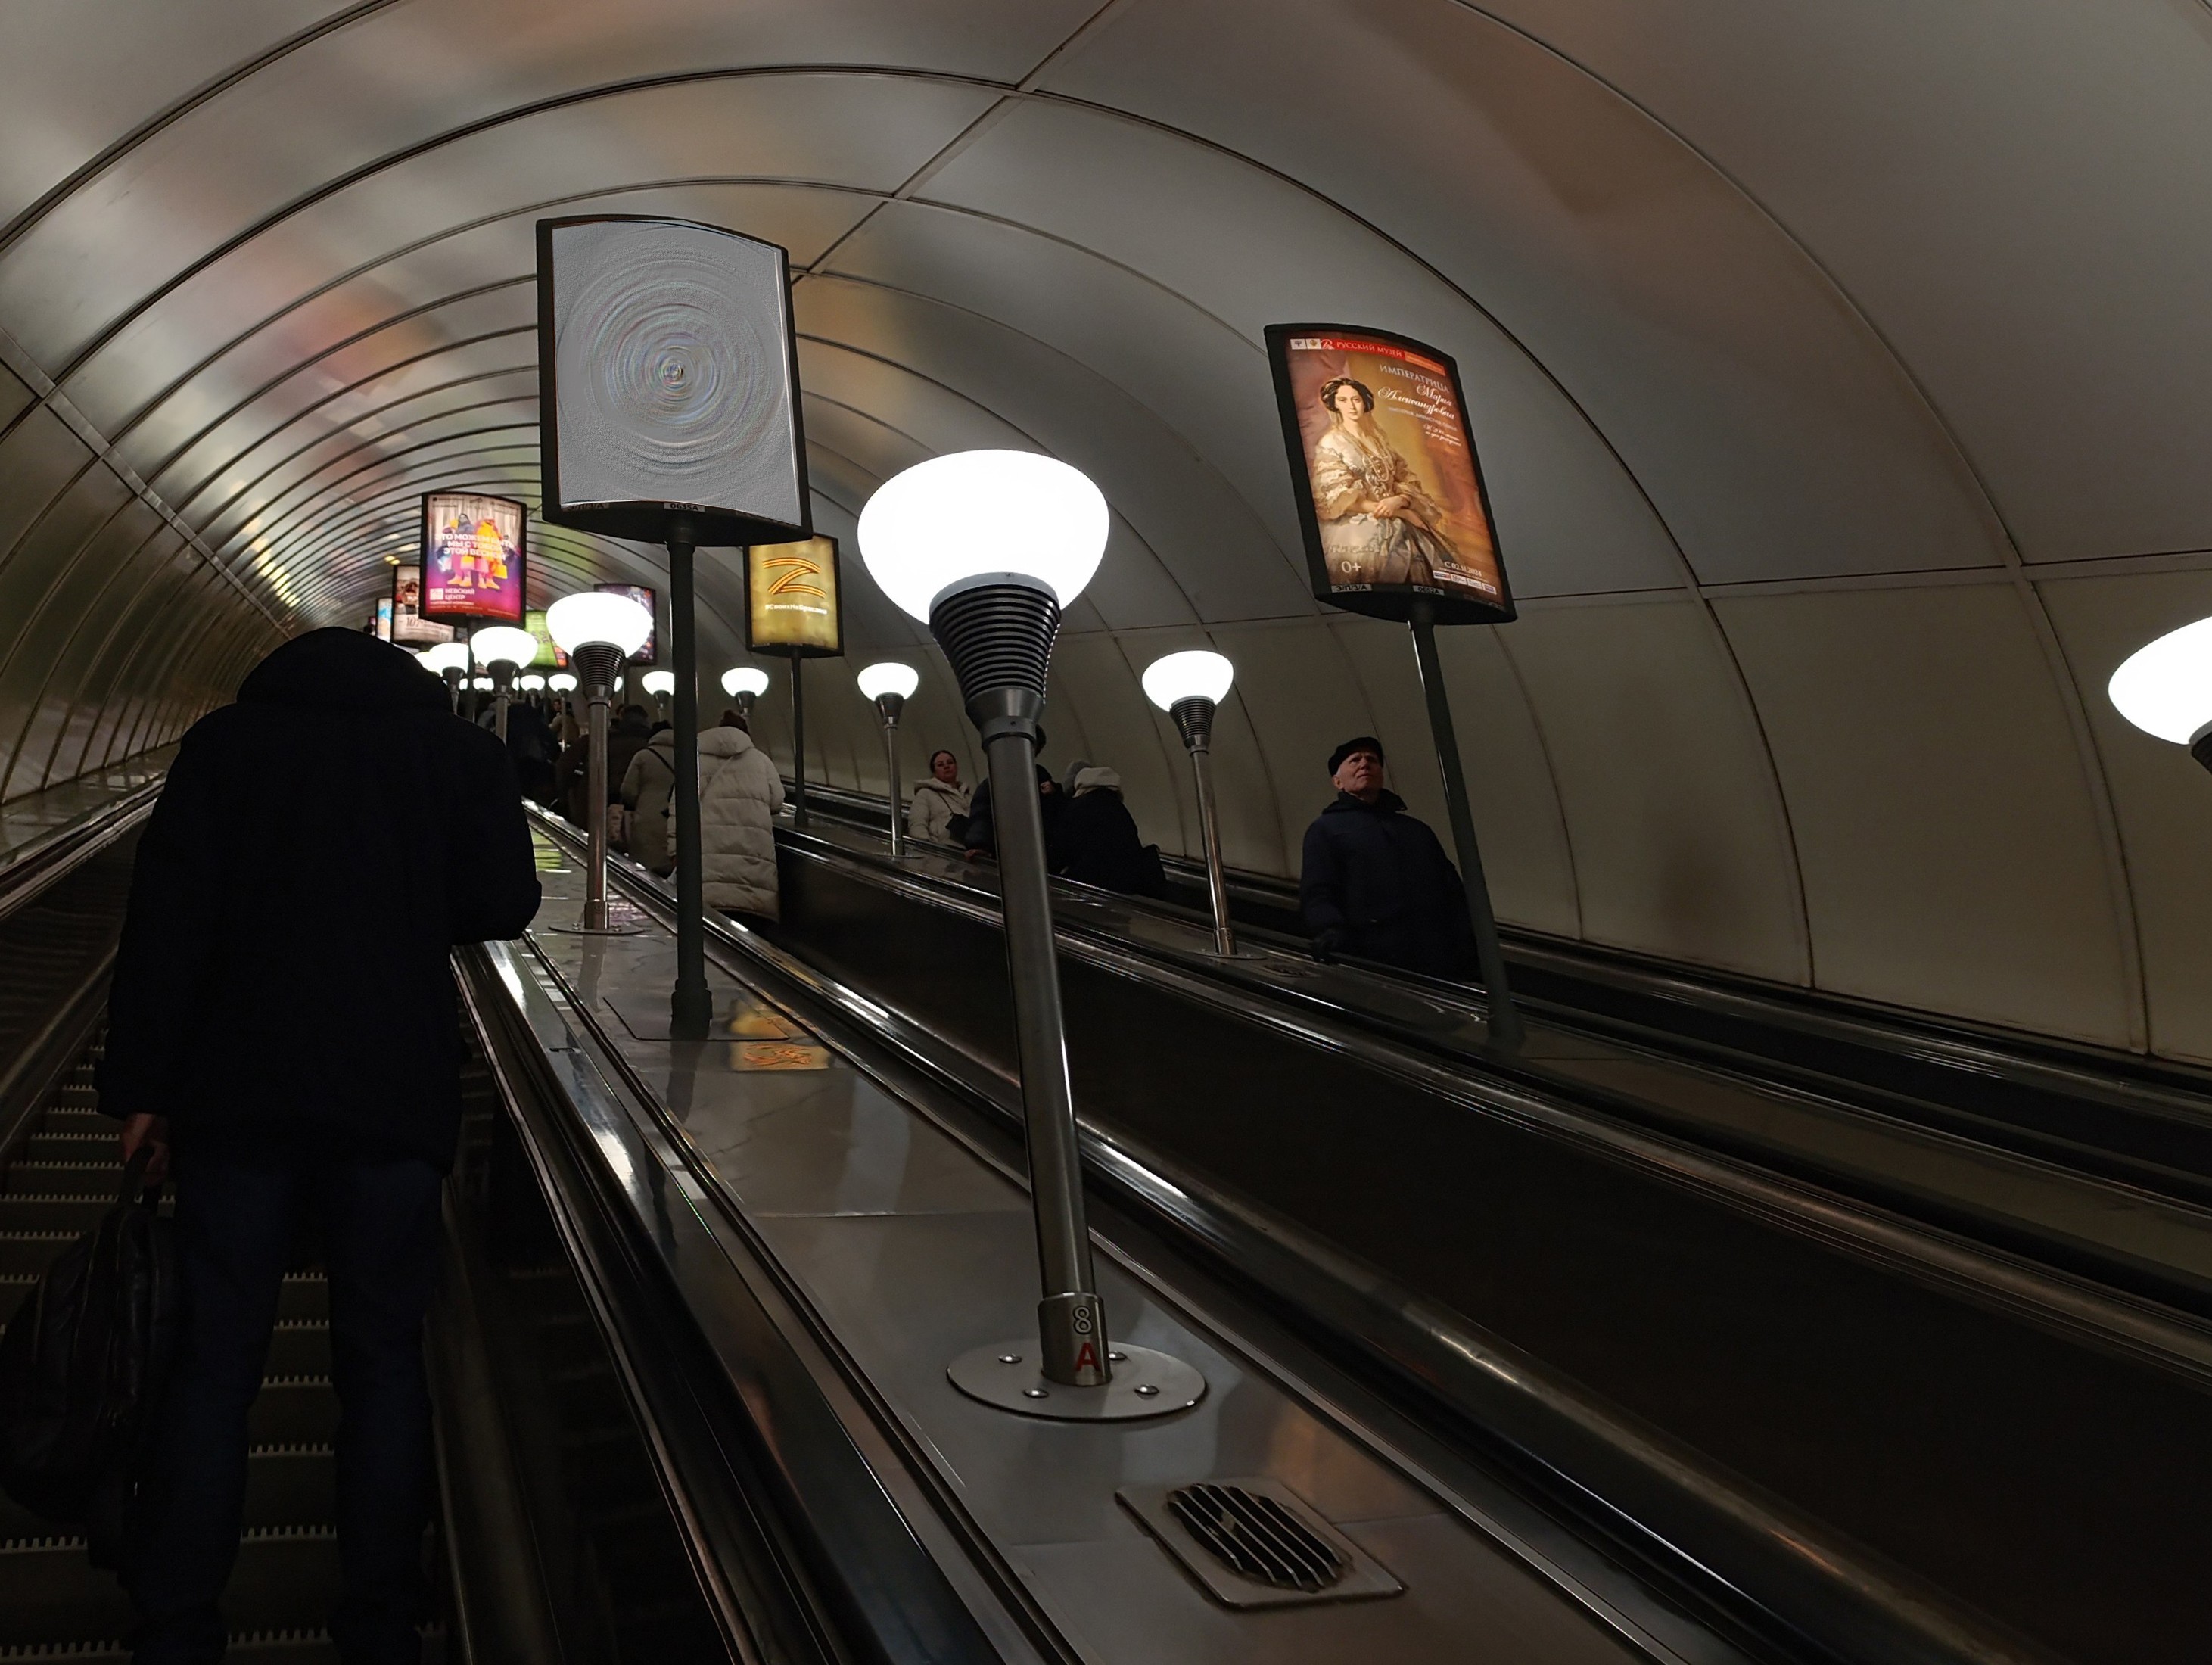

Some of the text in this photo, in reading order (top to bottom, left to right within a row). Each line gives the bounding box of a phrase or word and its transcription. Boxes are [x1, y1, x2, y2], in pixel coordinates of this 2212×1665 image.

[1336, 341, 1402, 357] РУССКИЙ МУЗЕЙ
[1380, 364, 1450, 393] ИМПЕРАТРИЦА
[1341, 560, 1362, 574] 0+
[1072, 1305, 1093, 1335] 8
